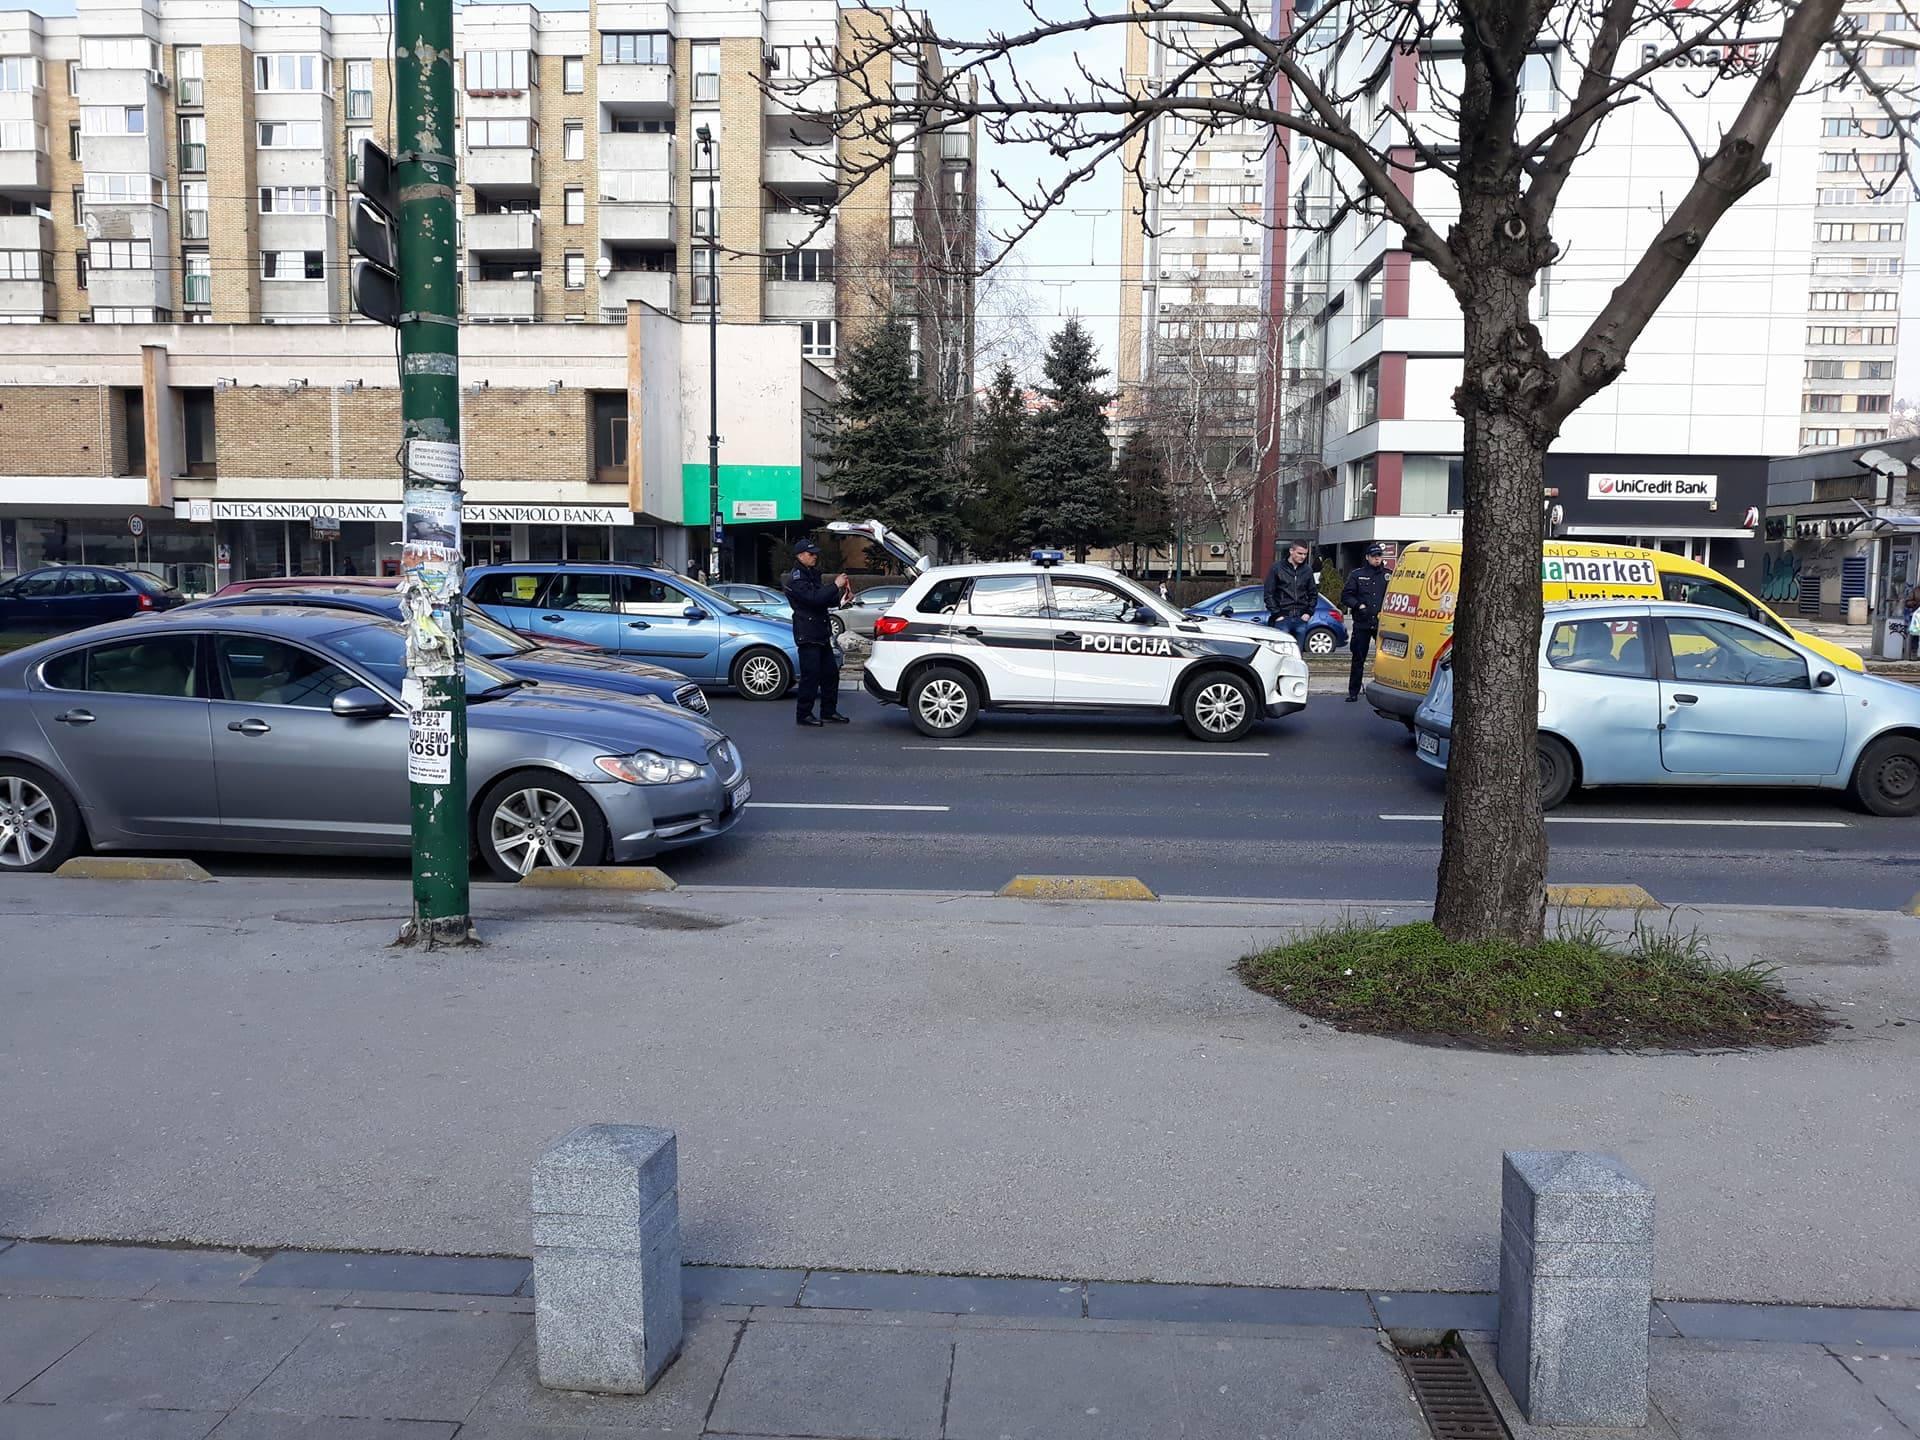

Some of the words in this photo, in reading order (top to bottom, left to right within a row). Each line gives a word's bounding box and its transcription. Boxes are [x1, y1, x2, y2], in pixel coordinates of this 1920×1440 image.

[1615, 479, 1672, 494] UniCredit
[1676, 480, 1708, 494] Bank
[216, 504, 262, 518] INTESA
[266, 504, 335, 519] SANPAOLO
[338, 505, 388, 520] BANKA
[462, 507, 485, 520] ESA
[488, 507, 560, 522] SANPAOLO
[563, 508, 614, 523] BANKA
[132, 520, 142, 532] 60
[1548, 548, 1579, 557] NO
[1590, 549, 1651, 559] SHOP
[1542, 560, 1653, 583] amarket
[1416, 608, 1454, 620] CADDY
[1081, 634, 1172, 655] POLICIJA
[410, 711, 446, 719] ebruar
[412, 717, 440, 726] 23-24
